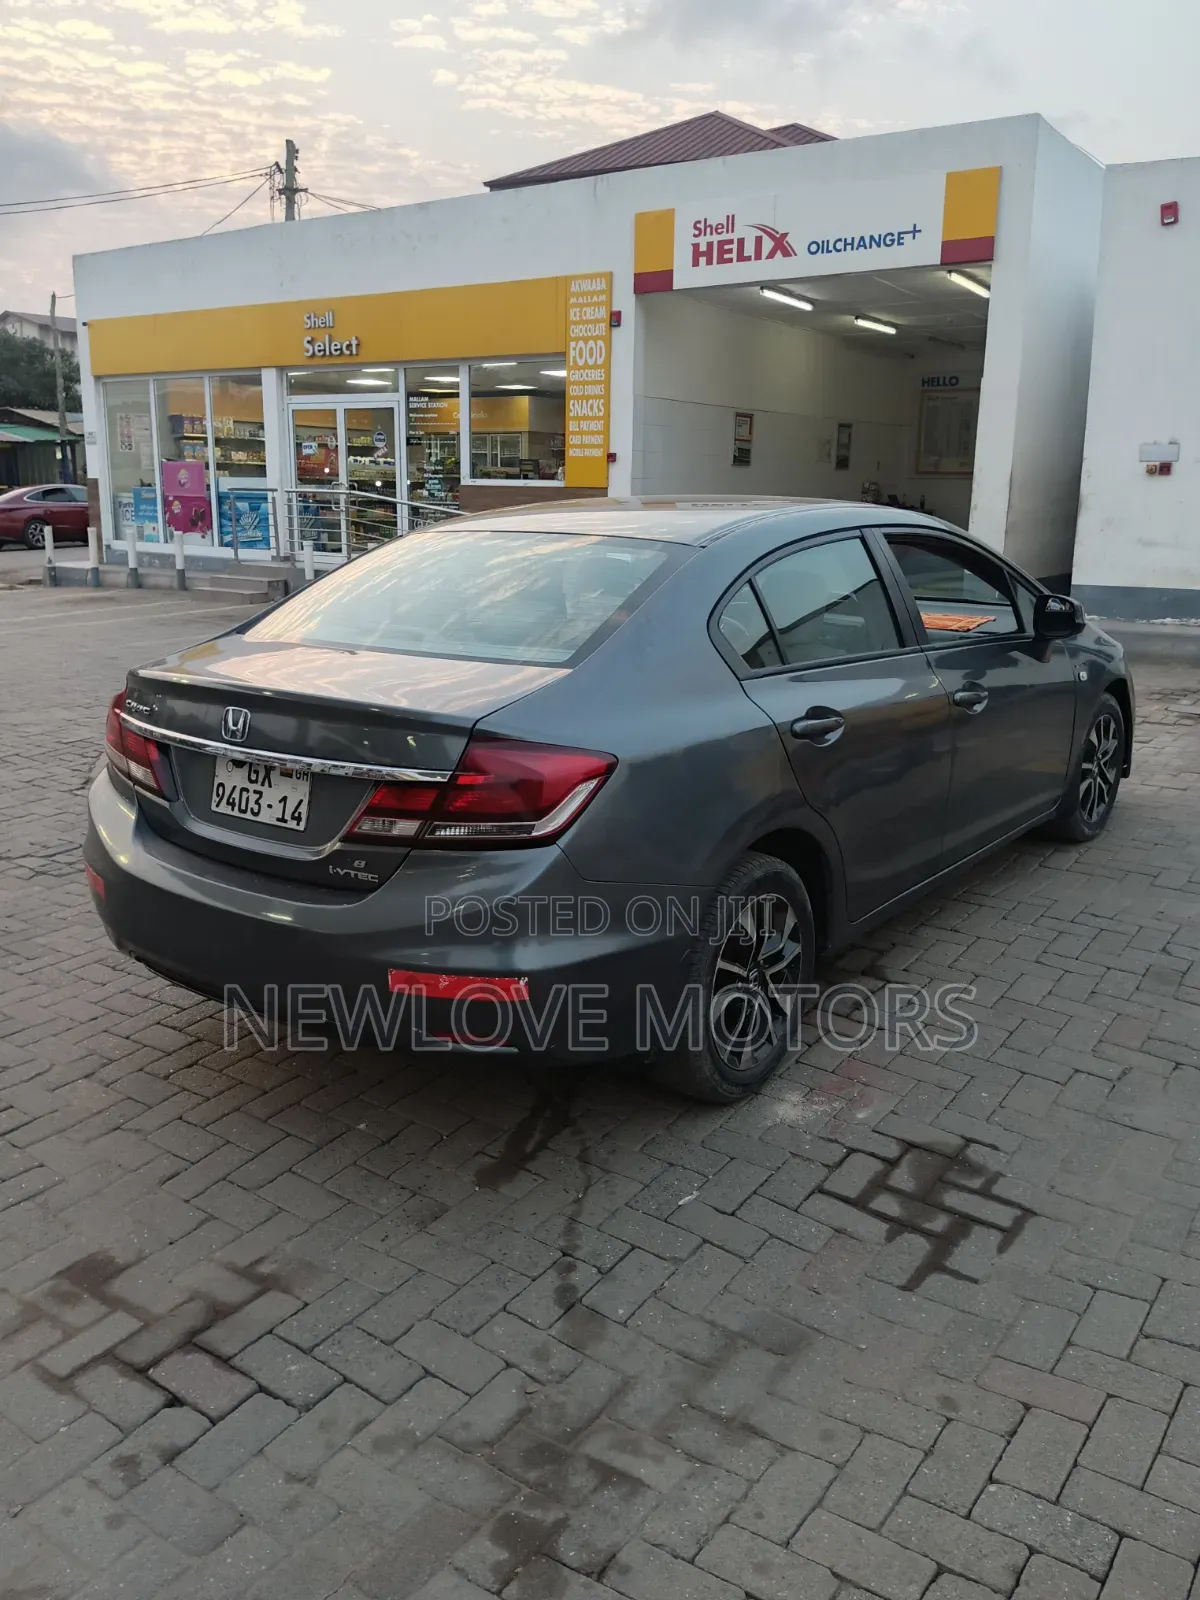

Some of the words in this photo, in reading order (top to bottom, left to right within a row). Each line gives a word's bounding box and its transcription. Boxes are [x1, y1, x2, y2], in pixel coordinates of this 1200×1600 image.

[692, 214, 735, 238] Shell
[691, 223, 797, 268] HELIX
[570, 278, 607, 293] AKWAABA
[570, 294, 607, 304] MALLAM
[570, 308, 580, 320] ICE
[582, 305, 606, 320] CREAM
[303, 311, 334, 330] Shell
[570, 323, 606, 338] CHOCOLATE
[303, 334, 359, 357] Select
[569, 340, 606, 367] FOOD
[569, 369, 605, 381] GROCERIES
[922, 376, 959, 388] HELLO
[569, 385, 583, 396] COLD
[584, 384, 605, 395] DRINKS
[569, 398, 604, 417] SNACKS
[569, 420, 579, 431] BILL
[580, 420, 604, 431] PAYMENT
[582, 434, 604, 445] PAYMENT
[247, 762, 276, 789] GX
[215, 782, 304, 827] 9403-14
